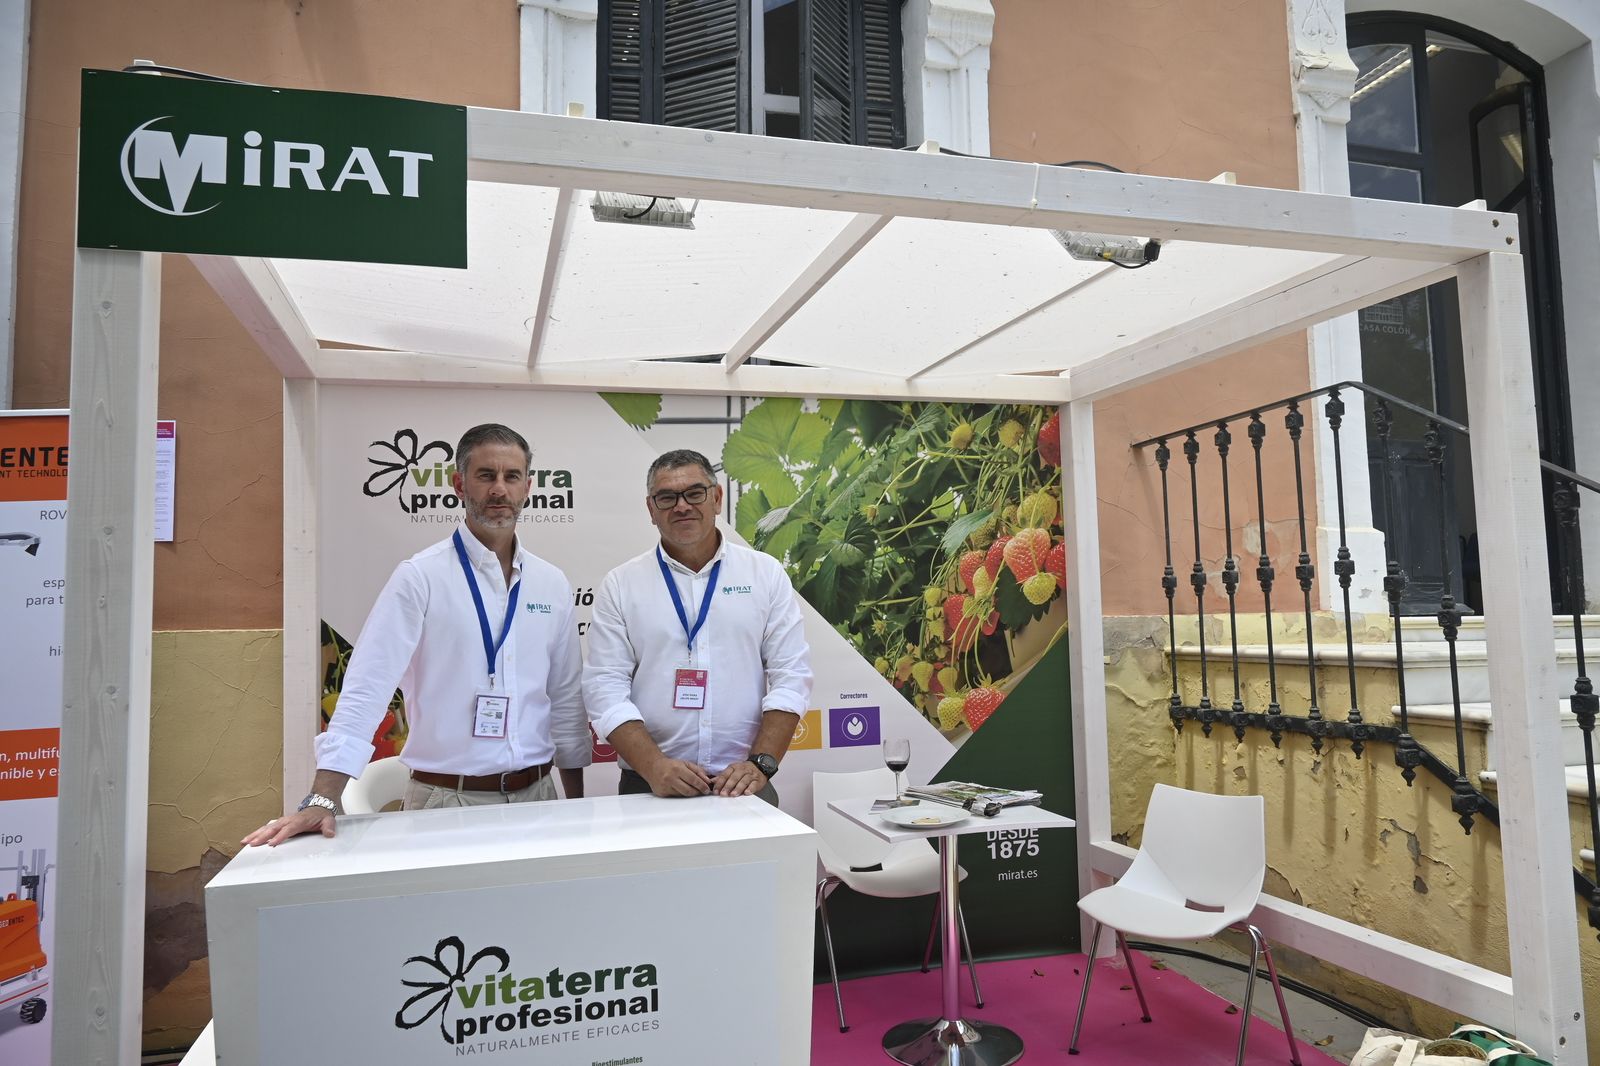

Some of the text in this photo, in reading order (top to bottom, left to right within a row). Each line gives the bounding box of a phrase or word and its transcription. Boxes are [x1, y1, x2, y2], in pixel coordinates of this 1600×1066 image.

[26, 597, 55, 608] para
[38, 768, 46, 780] y
[986, 828, 1039, 841] DESDE
[987, 838, 1040, 860] 1875
[998, 869, 1038, 881] mirat.es
[456, 963, 658, 1009] vitaterra
[455, 988, 659, 1044] profesional
[455, 1019, 660, 1056] NATURALMENTE EFICACES
